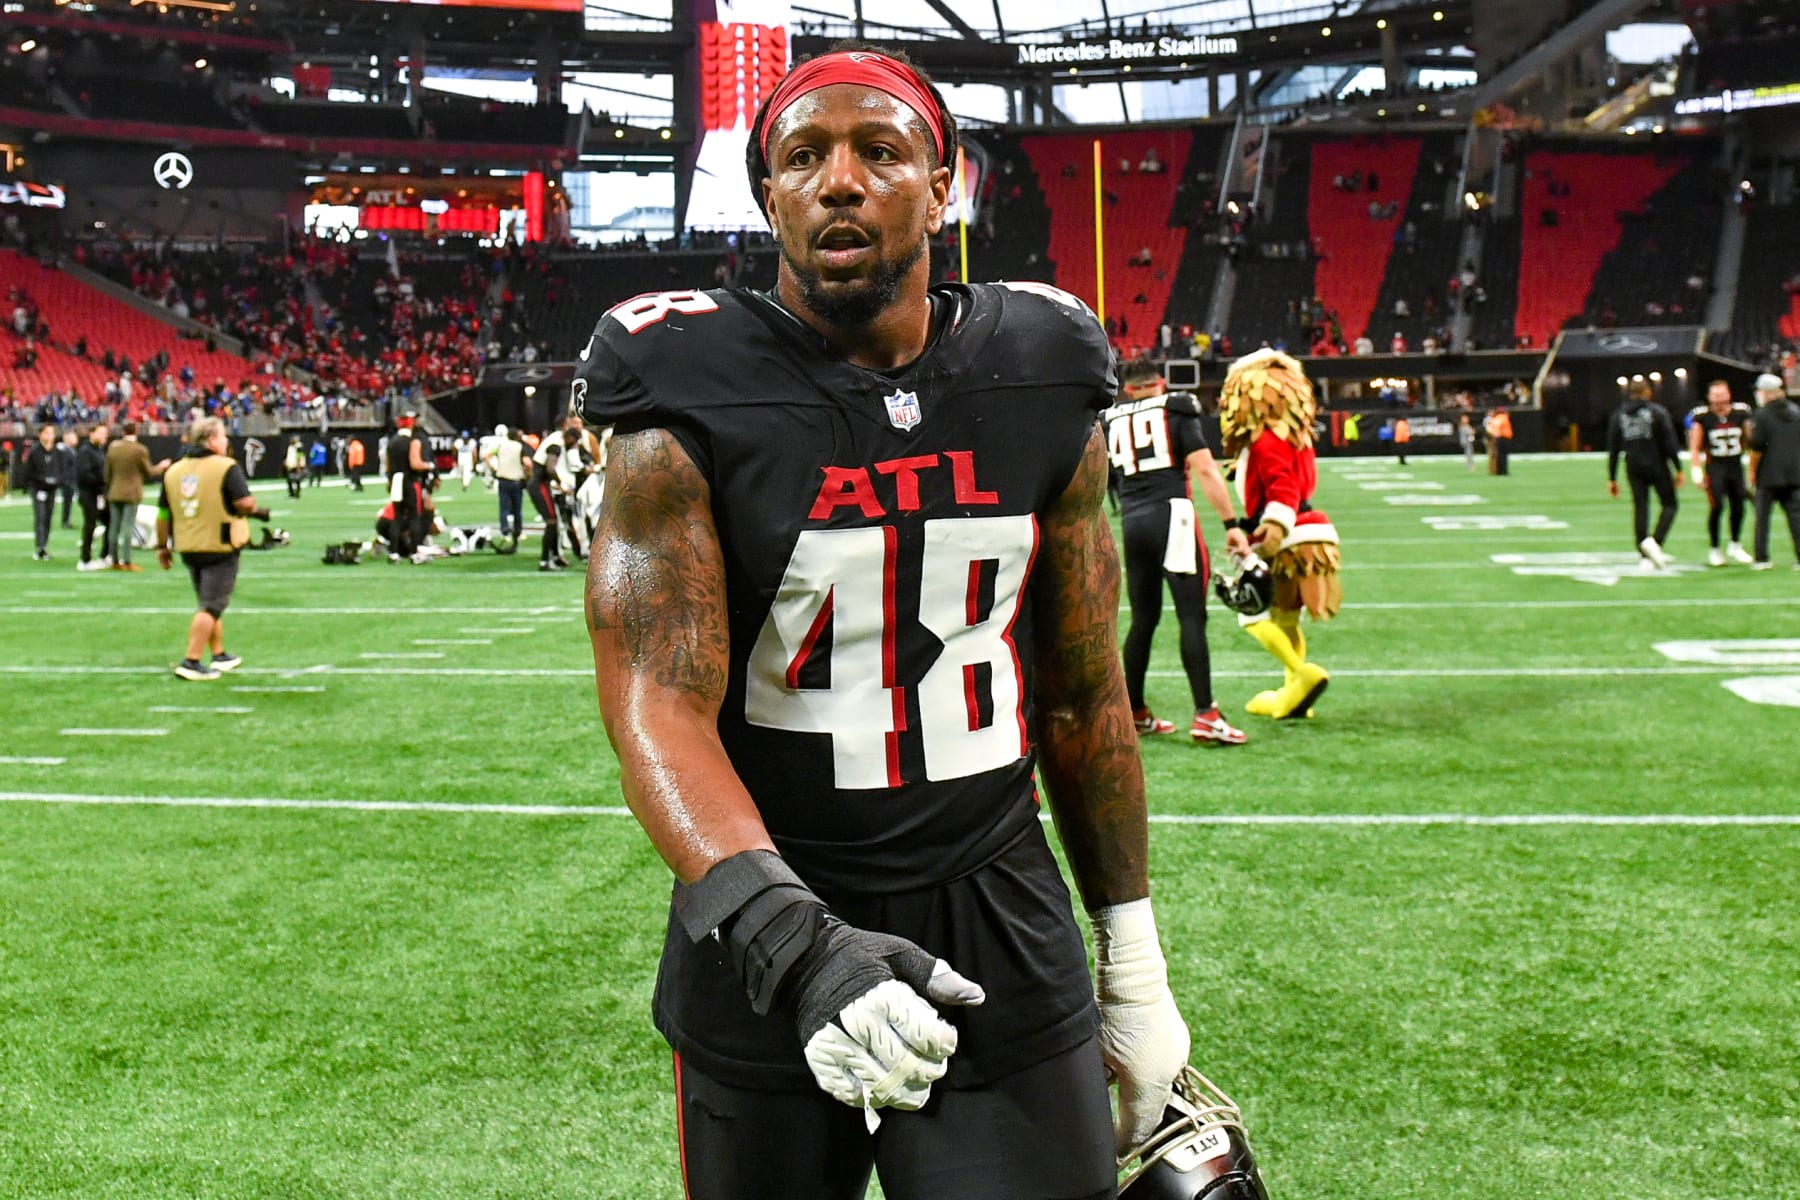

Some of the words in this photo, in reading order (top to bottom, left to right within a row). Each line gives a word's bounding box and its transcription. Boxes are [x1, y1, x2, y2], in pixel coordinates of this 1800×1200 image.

[1018, 39, 1155, 63] Mercedes-Benz
[1159, 36, 1238, 57] Stadium
[365, 190, 408, 205] ATL
[893, 407, 917, 423] NFL
[1108, 407, 1175, 476] 49
[1708, 427, 1742, 457] 53
[808, 451, 999, 520] ATL
[745, 512, 1039, 790] 48
[1185, 1134, 1219, 1155] ATL
